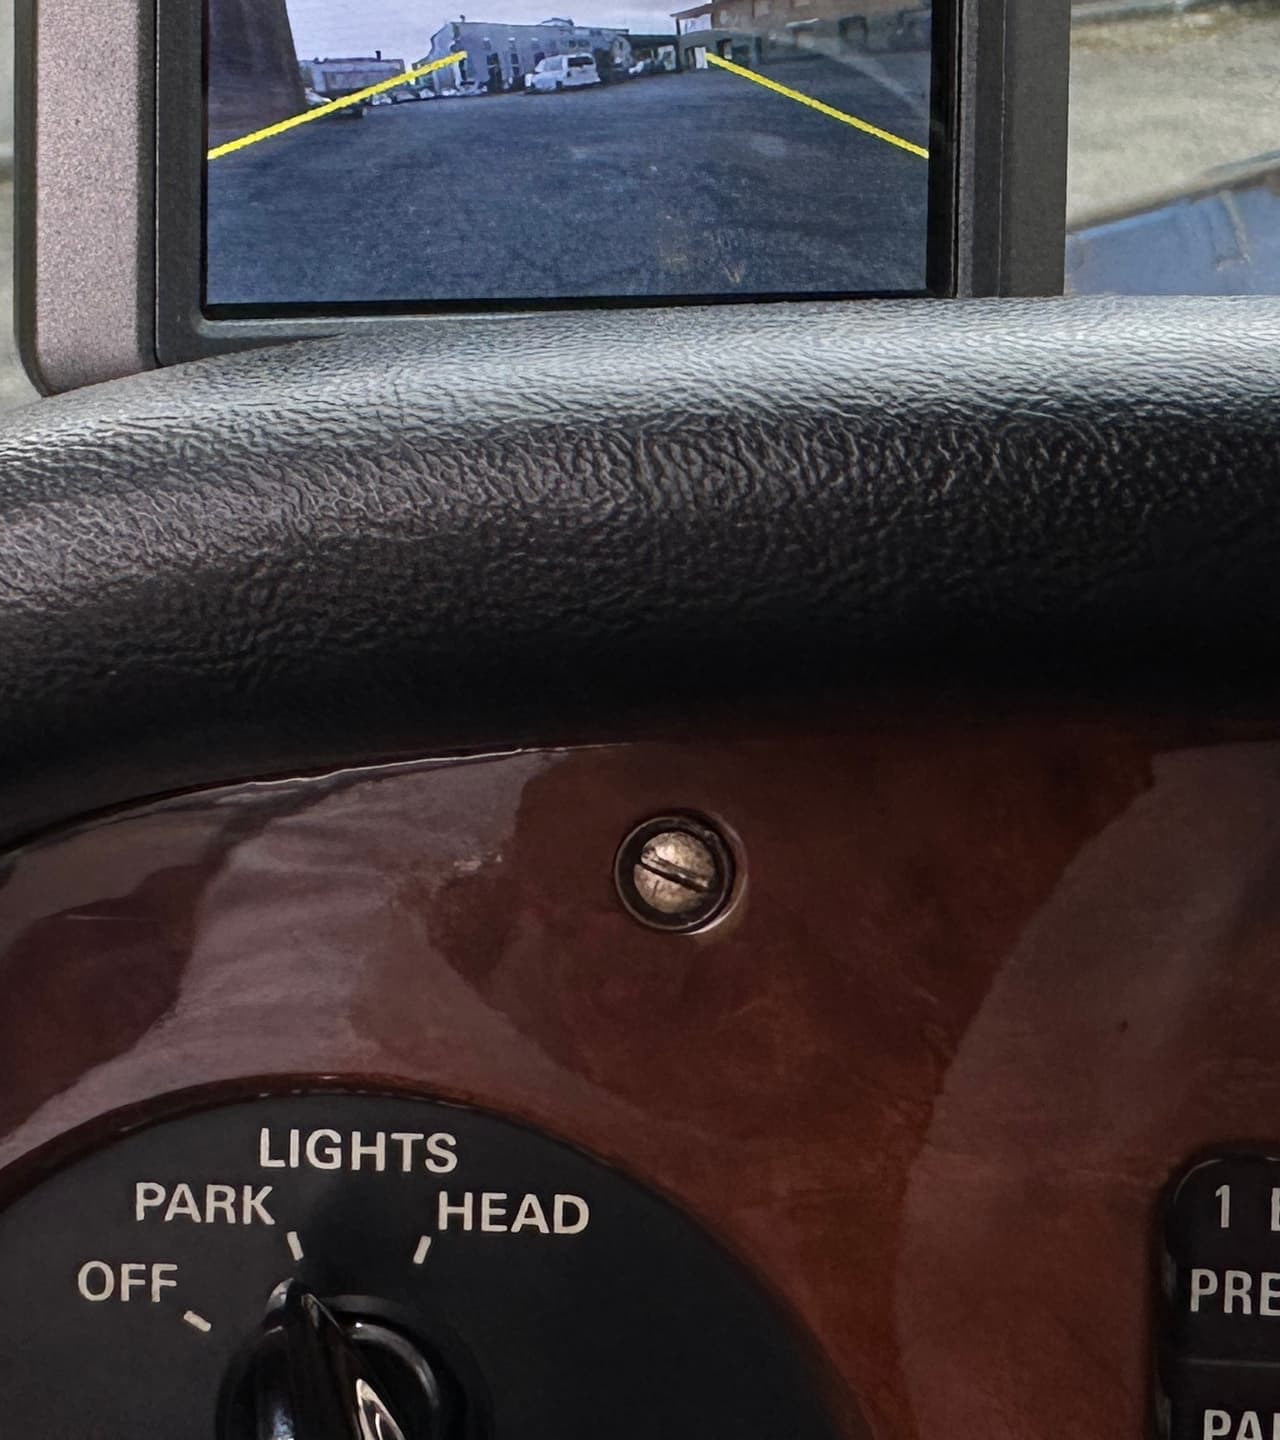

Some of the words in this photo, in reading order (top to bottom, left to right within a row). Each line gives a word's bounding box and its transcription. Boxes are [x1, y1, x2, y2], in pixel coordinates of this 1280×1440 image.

[259, 1127, 458, 1174] LIGHTS
[135, 1182, 276, 1226] PARK
[438, 1190, 590, 1235] HEAD
[1215, 1184, 1232, 1229] 1
[77, 1260, 178, 1303] OFF
